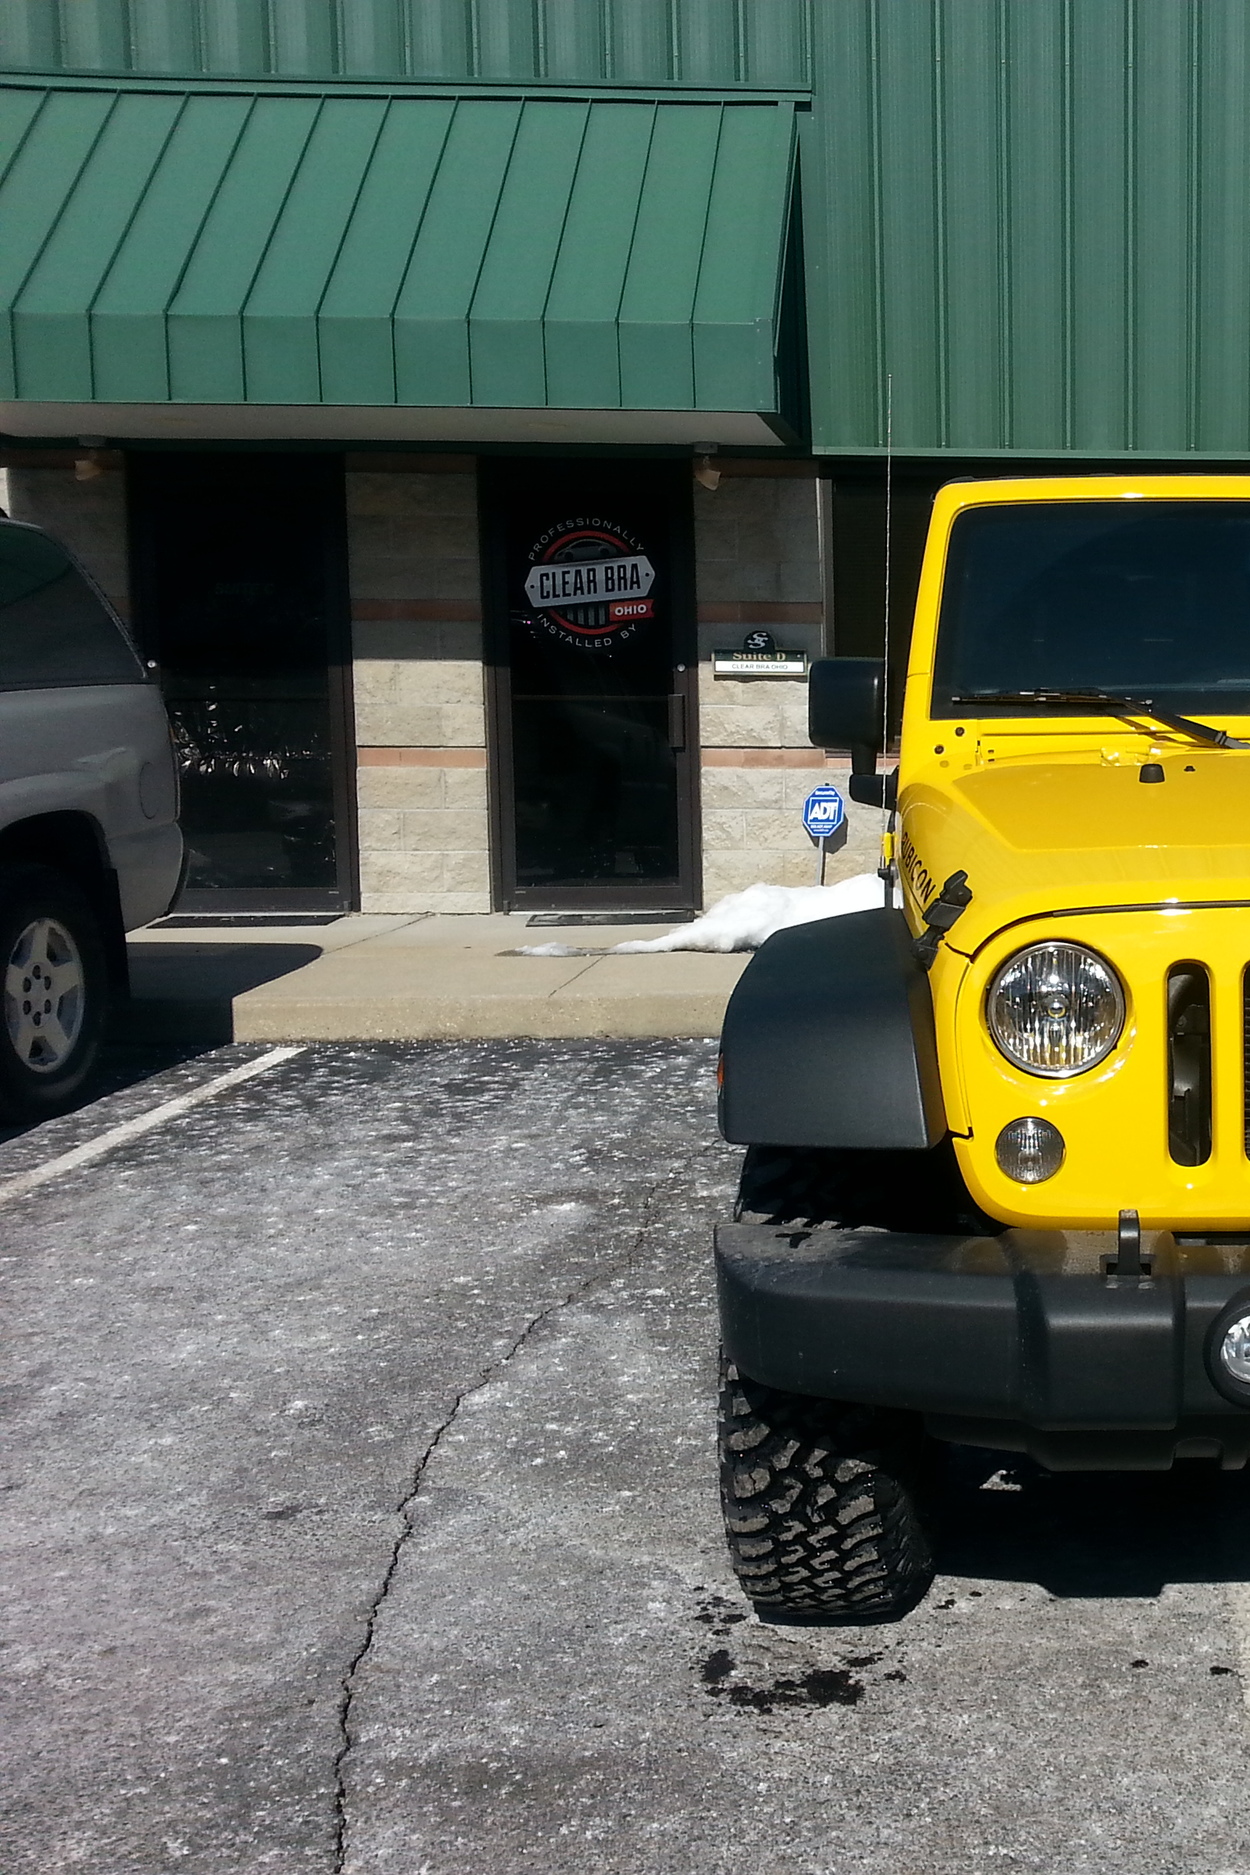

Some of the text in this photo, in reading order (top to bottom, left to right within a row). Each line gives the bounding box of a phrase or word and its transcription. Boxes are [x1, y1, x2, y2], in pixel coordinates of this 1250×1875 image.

[528, 518, 644, 561] PROFESSIONALLY
[540, 563, 641, 599] CLEAR BRA
[615, 604, 647, 616] OHIO
[537, 613, 636, 647] INSTALLED BY
[732, 652, 786, 661] Suite D
[809, 802, 838, 820] ADT
